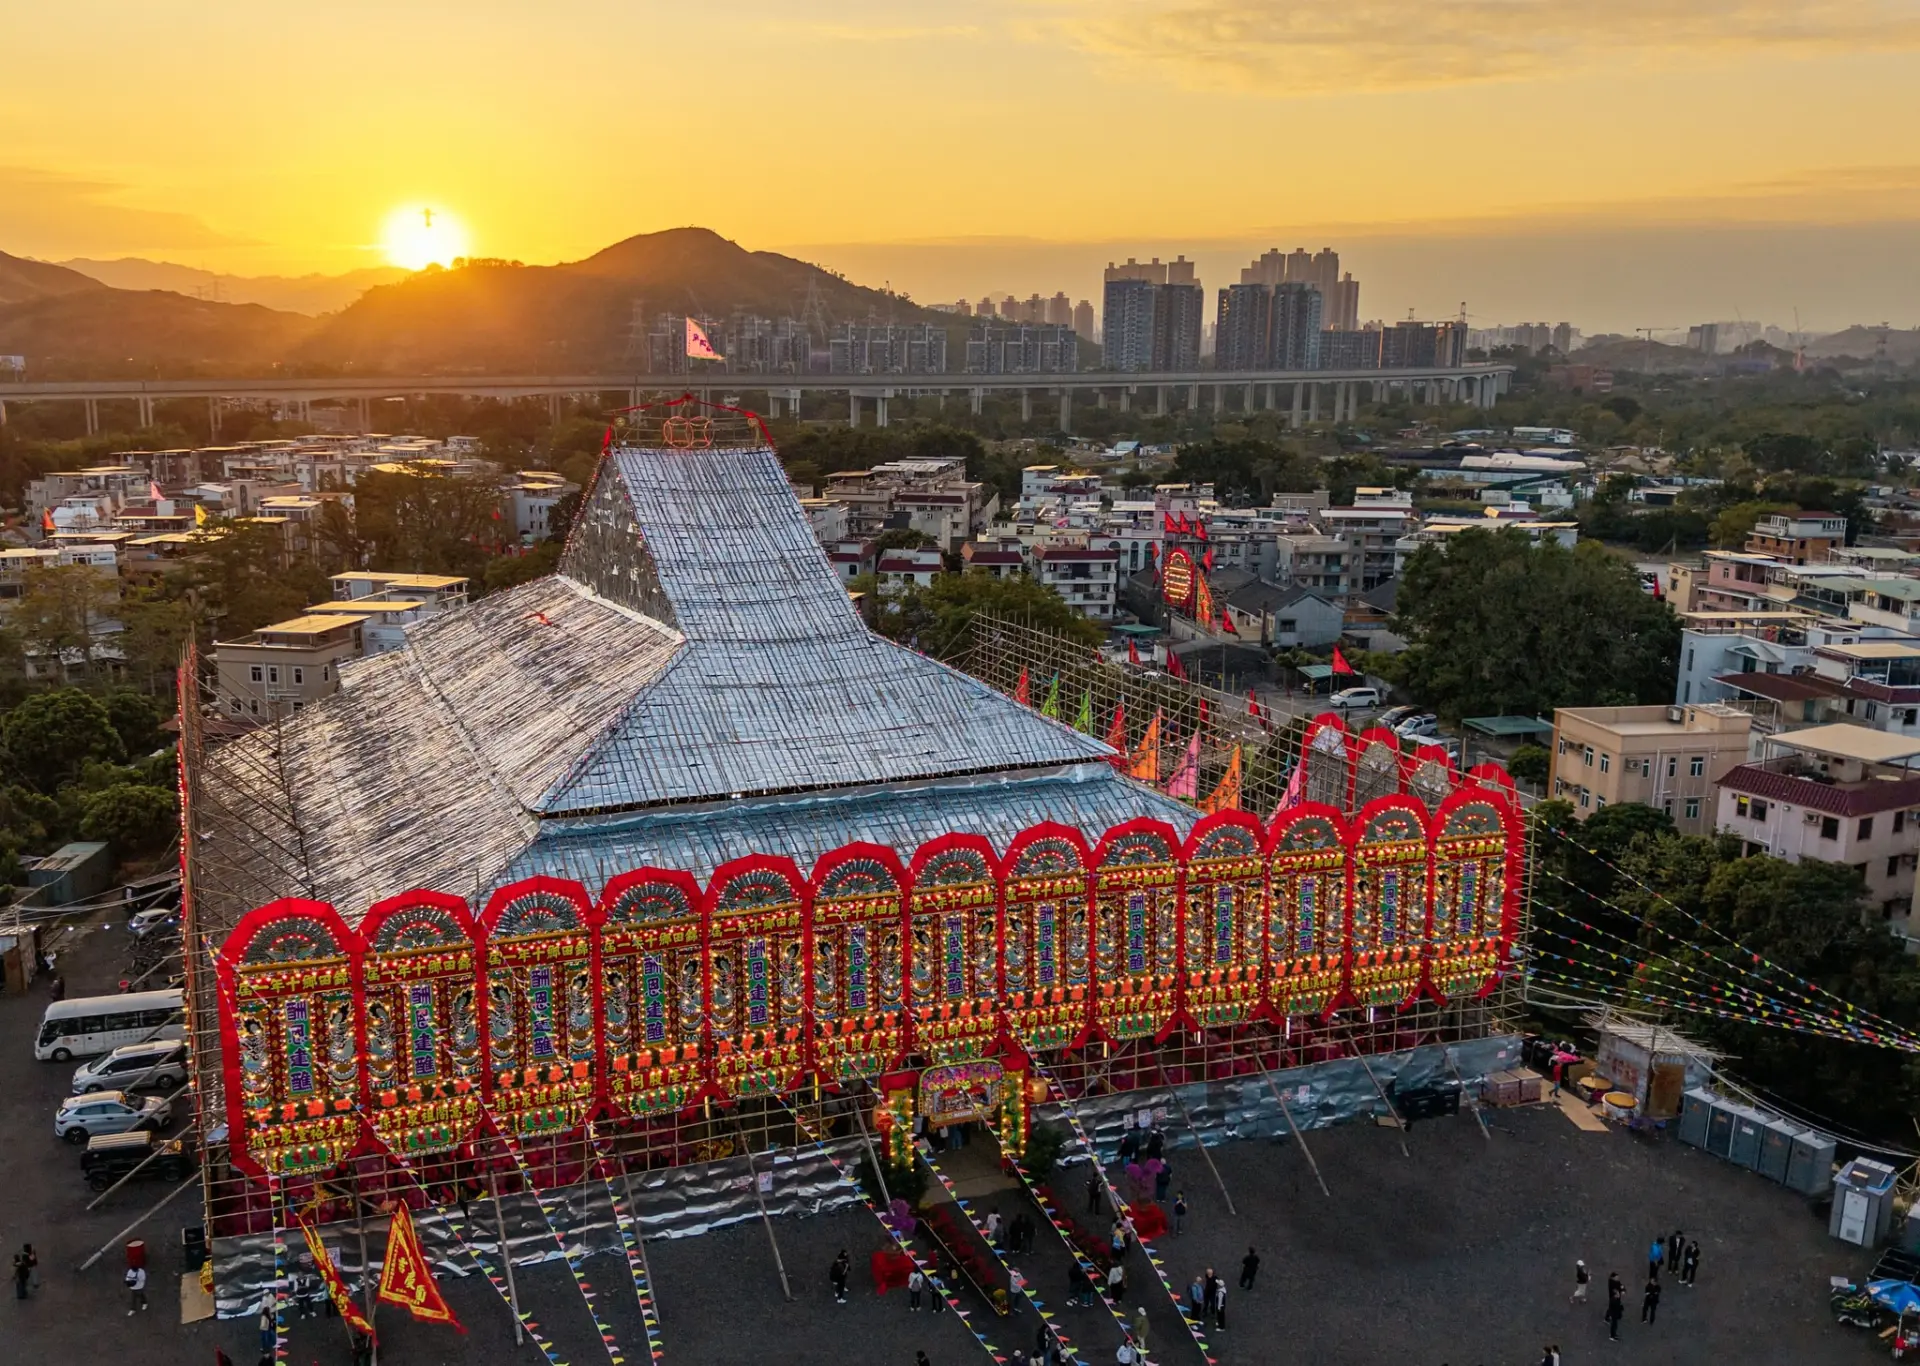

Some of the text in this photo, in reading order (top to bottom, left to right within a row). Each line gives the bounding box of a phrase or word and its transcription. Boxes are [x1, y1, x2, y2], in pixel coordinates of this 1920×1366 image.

[850, 927, 867, 1009] 酬恩建醮
[1129, 895, 1144, 971] 酬恩建醮
[530, 968, 554, 1057] 酬恩建醮
[643, 955, 665, 1041] 酬恩建醮
[749, 939, 768, 1025] 酬恩建醮
[284, 999, 313, 1092] 酬恩建醮
[410, 986, 436, 1077] 酬恩建醮
